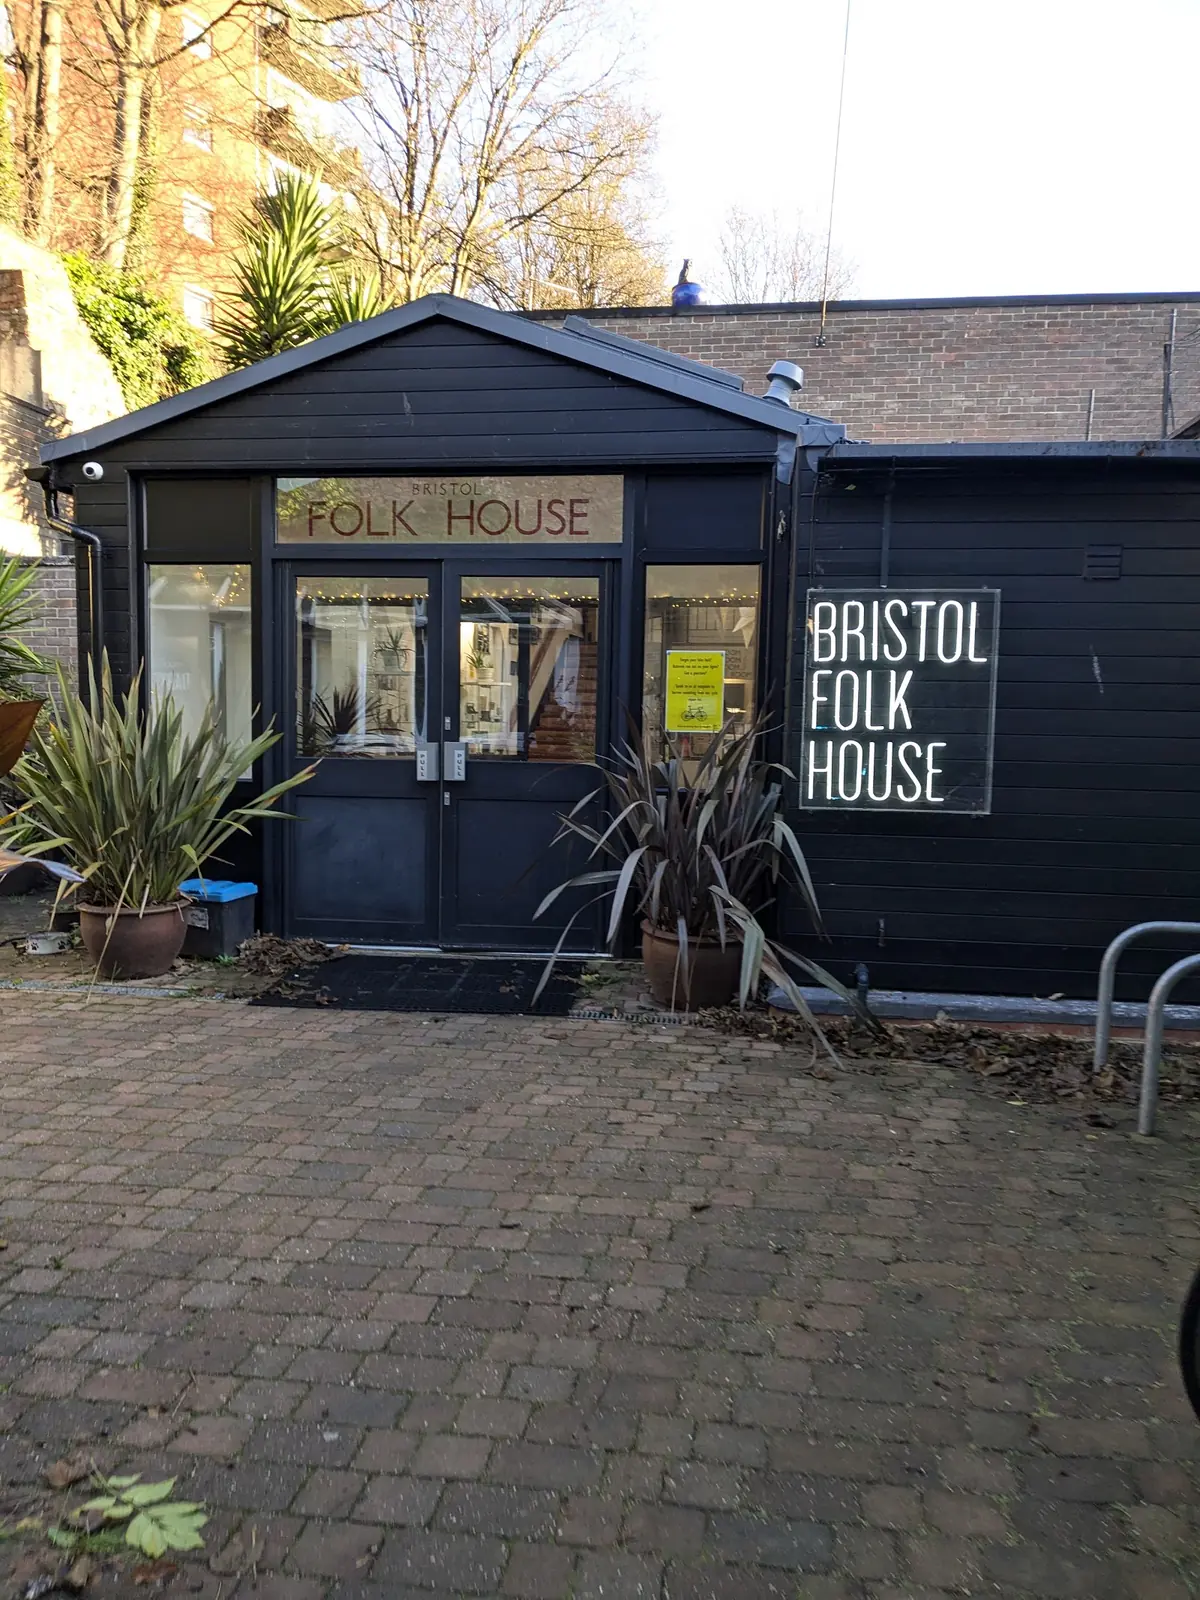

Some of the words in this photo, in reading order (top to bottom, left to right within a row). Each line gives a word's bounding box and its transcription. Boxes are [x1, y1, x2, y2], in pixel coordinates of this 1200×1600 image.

[308, 500, 418, 537] FOLK
[447, 499, 590, 536] HOUSE
[411, 482, 482, 496] BRISTOL
[813, 599, 988, 663] BRISTOL
[811, 669, 914, 731] FOLK
[807, 740, 947, 802] HOUSE
